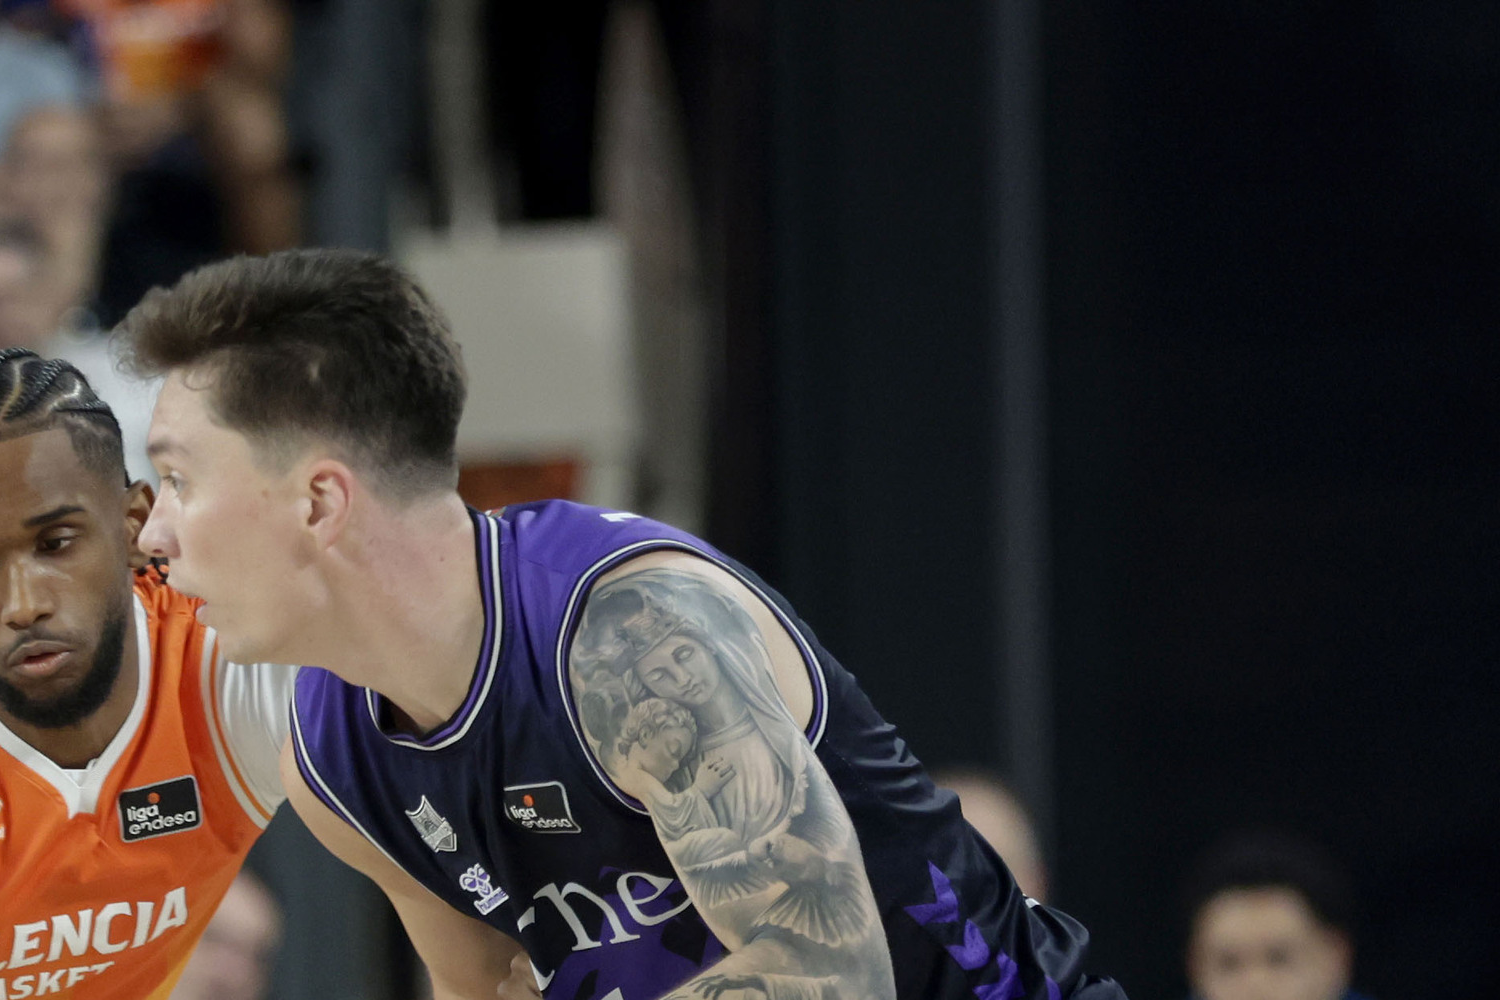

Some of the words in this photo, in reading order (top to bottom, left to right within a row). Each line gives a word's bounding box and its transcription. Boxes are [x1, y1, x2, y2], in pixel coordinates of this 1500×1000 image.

[126, 804, 159, 822] liga
[510, 804, 538, 820] liga
[128, 810, 197, 835] endesa
[515, 816, 573, 829] endesa
[517, 870, 692, 991] ne
